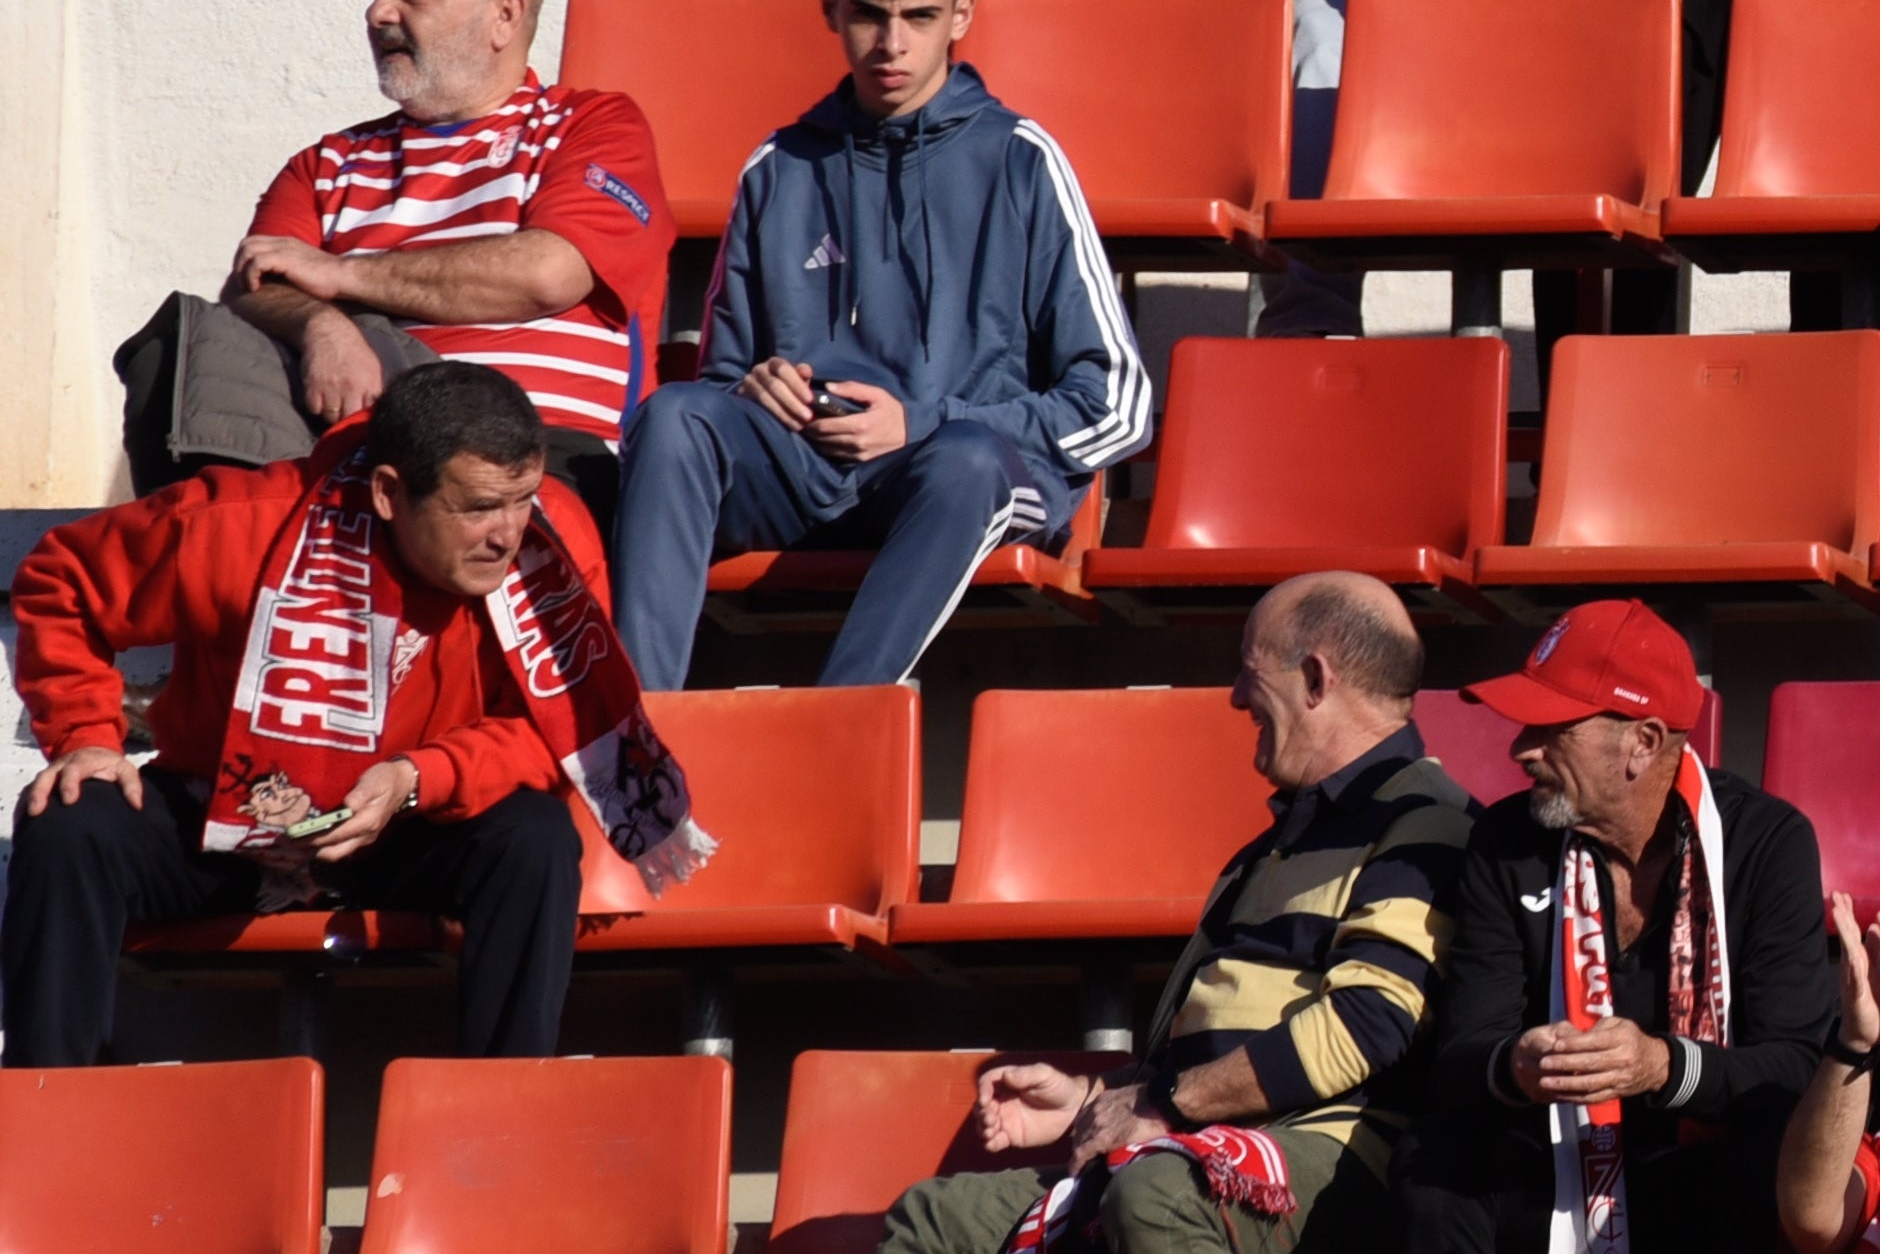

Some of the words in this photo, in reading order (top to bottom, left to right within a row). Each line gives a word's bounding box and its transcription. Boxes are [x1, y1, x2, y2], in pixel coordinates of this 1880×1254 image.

[605, 179, 650, 221] RESPECT
[250, 503, 377, 753] FRENTE
[502, 551, 608, 698] RAS
